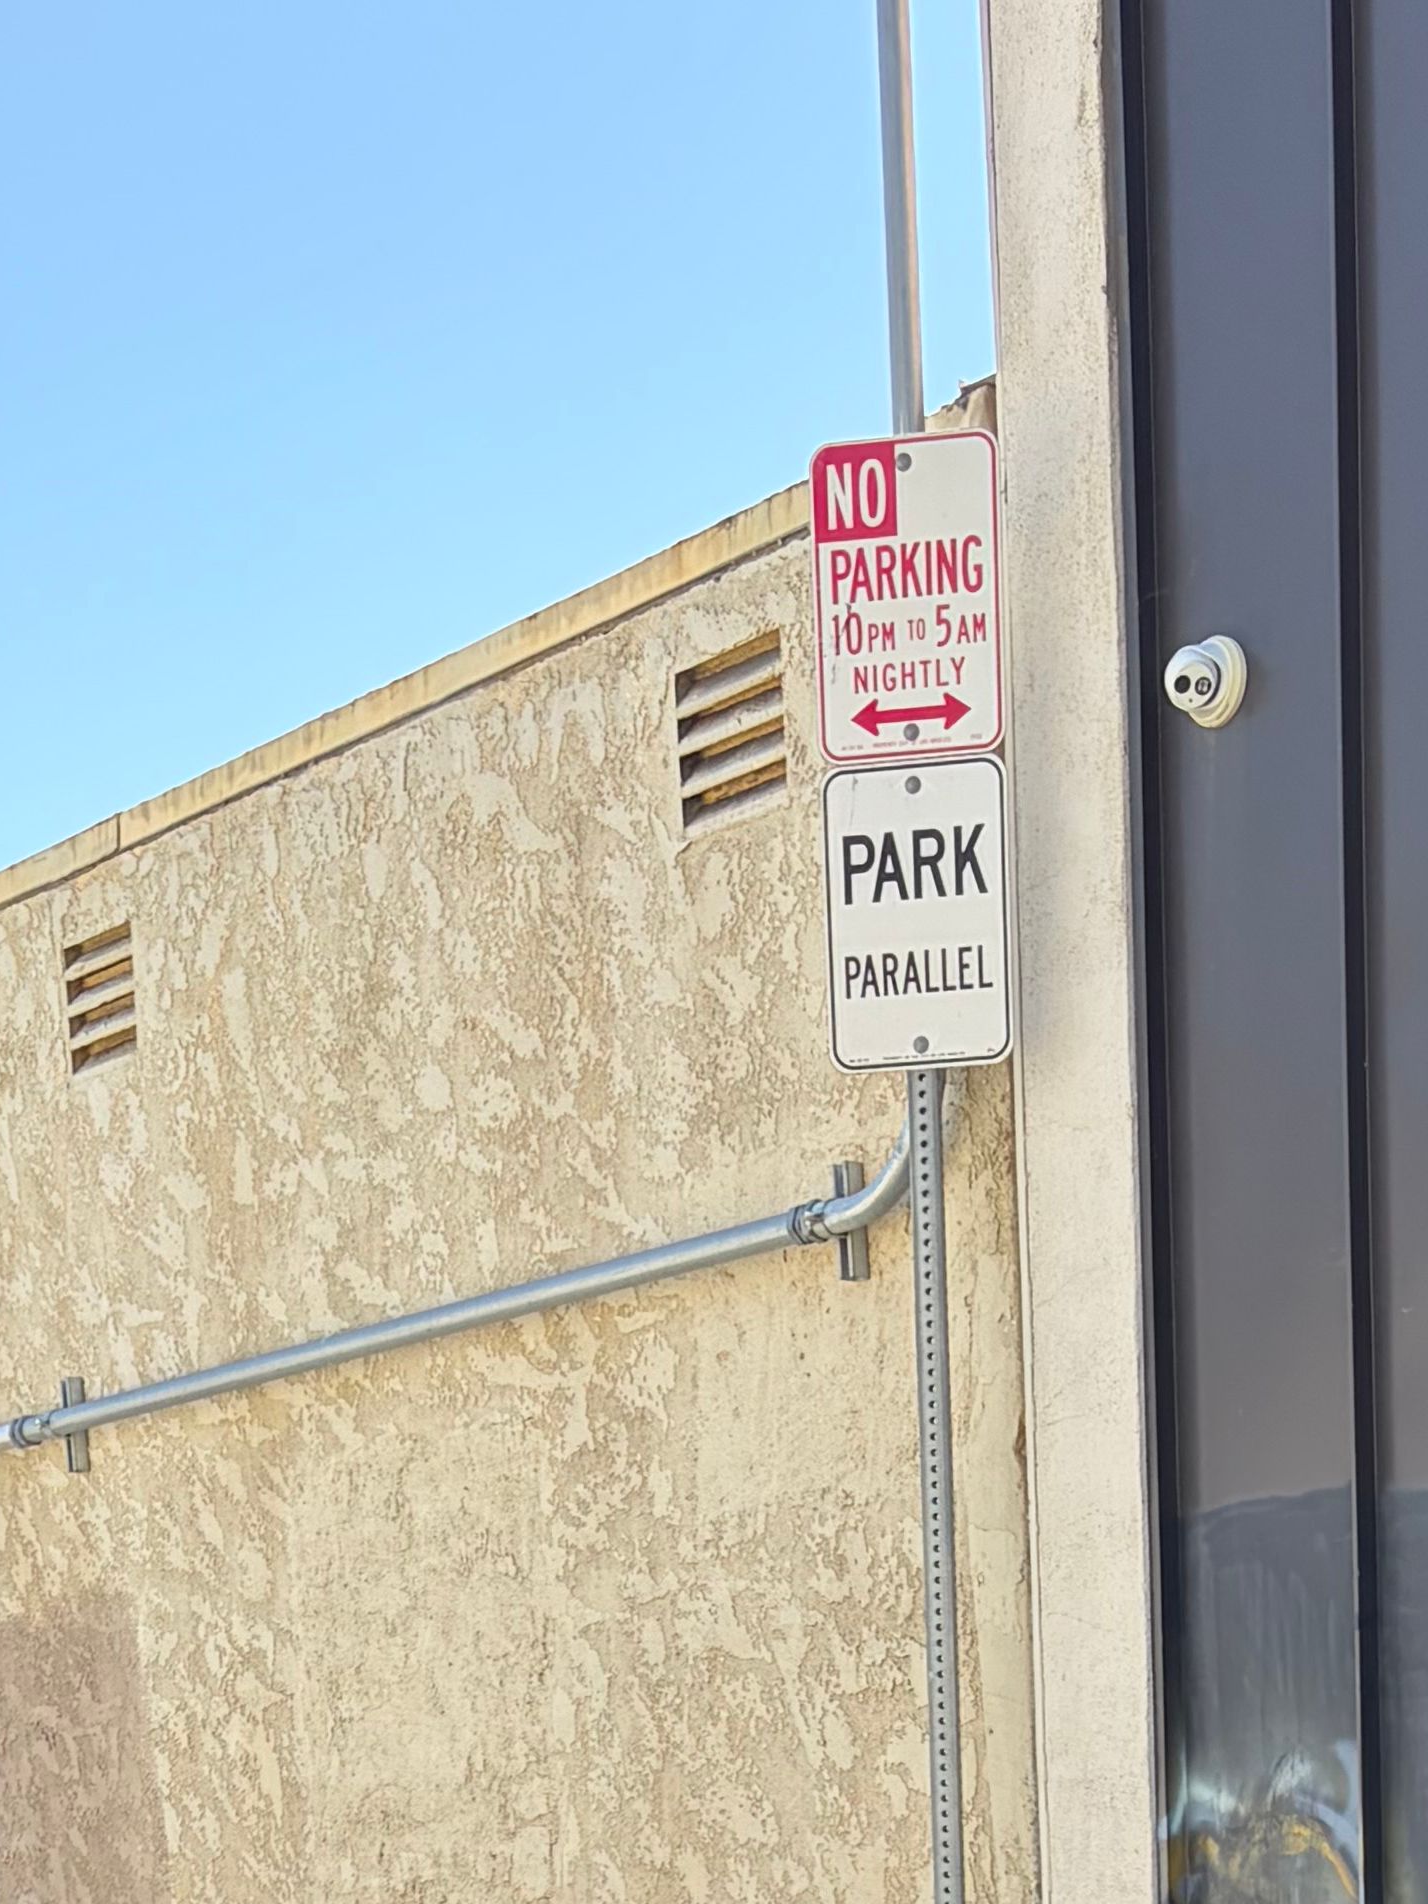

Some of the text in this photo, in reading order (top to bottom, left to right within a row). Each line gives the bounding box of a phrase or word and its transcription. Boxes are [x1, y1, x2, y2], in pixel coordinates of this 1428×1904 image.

[826, 458, 887, 531] NO
[830, 534, 983, 605] PARKING
[832, 604, 987, 656] 10PM TO 5AM
[853, 656, 965, 695] NIGHTLY
[842, 823, 988, 905] PARK
[844, 944, 994, 1000] PARALLEL
